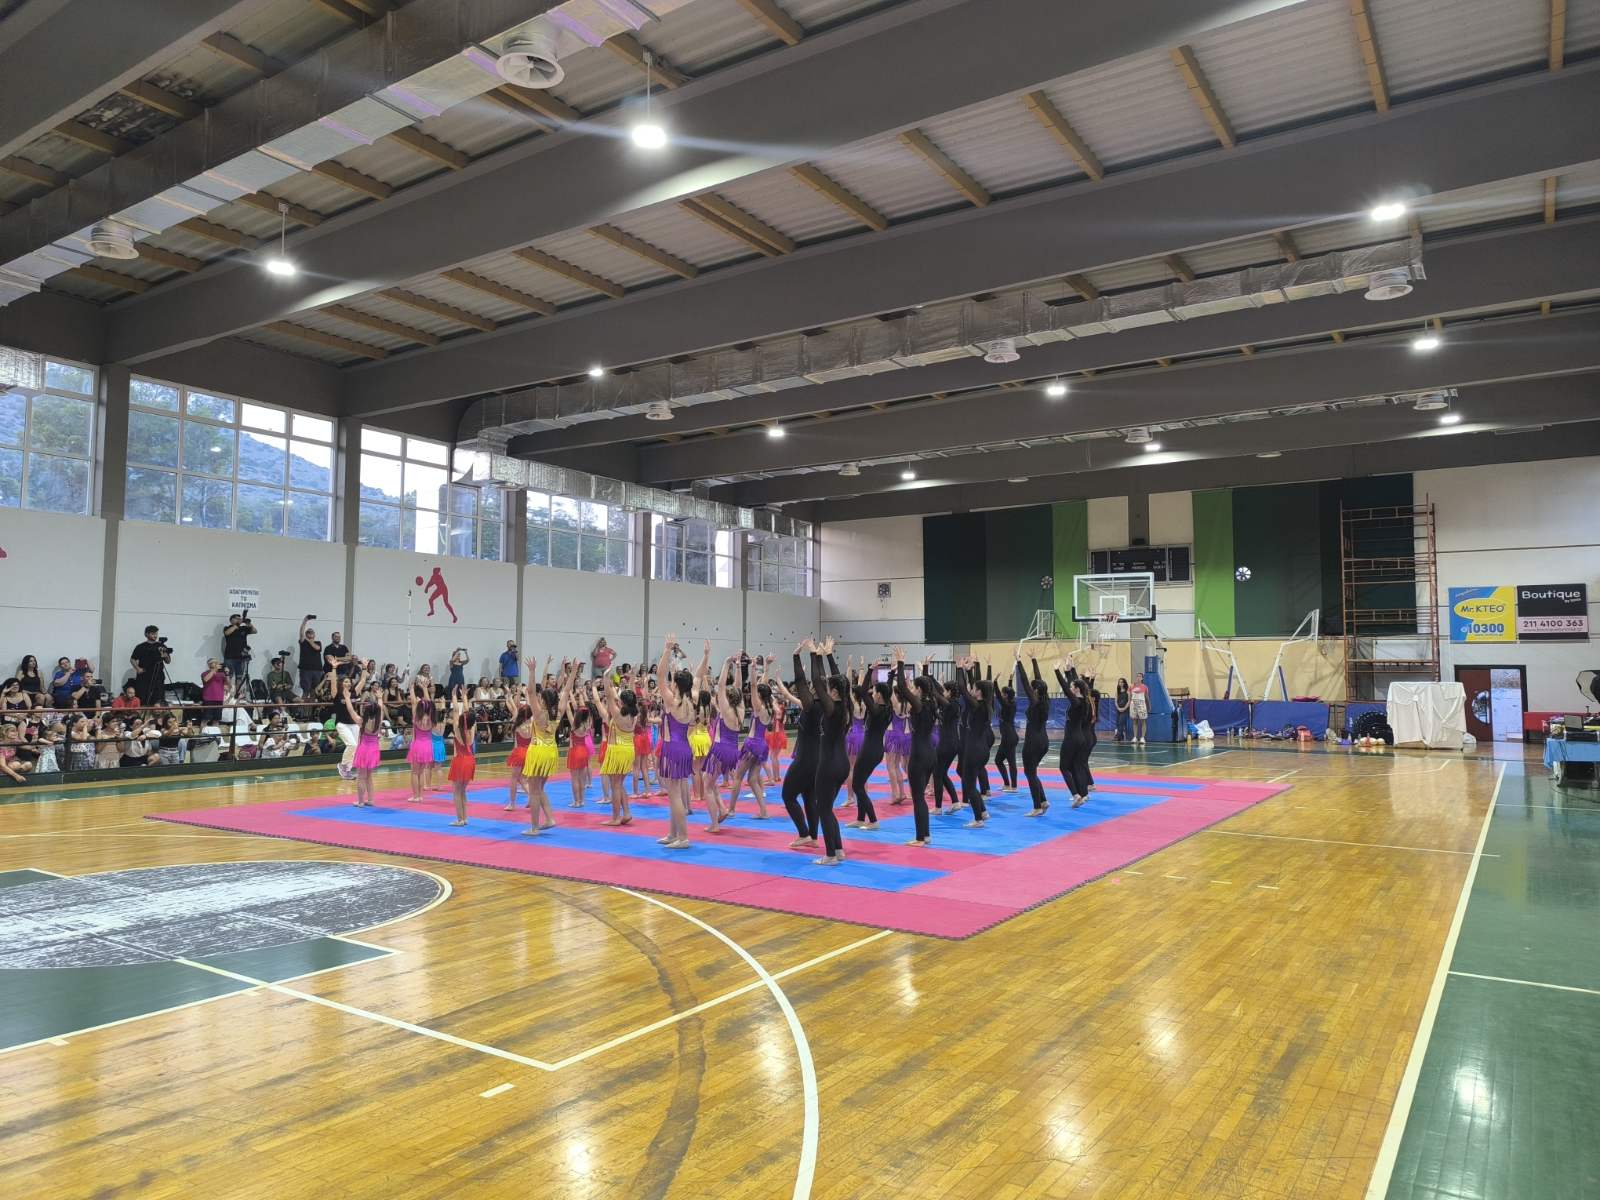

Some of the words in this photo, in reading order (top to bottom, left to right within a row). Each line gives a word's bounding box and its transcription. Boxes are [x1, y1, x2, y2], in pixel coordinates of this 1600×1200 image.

[1521, 590, 1581, 600] Boutique
[1468, 623, 1504, 634] 10300
[1523, 620, 1537, 628] 211
[1566, 619, 1584, 627] 363
